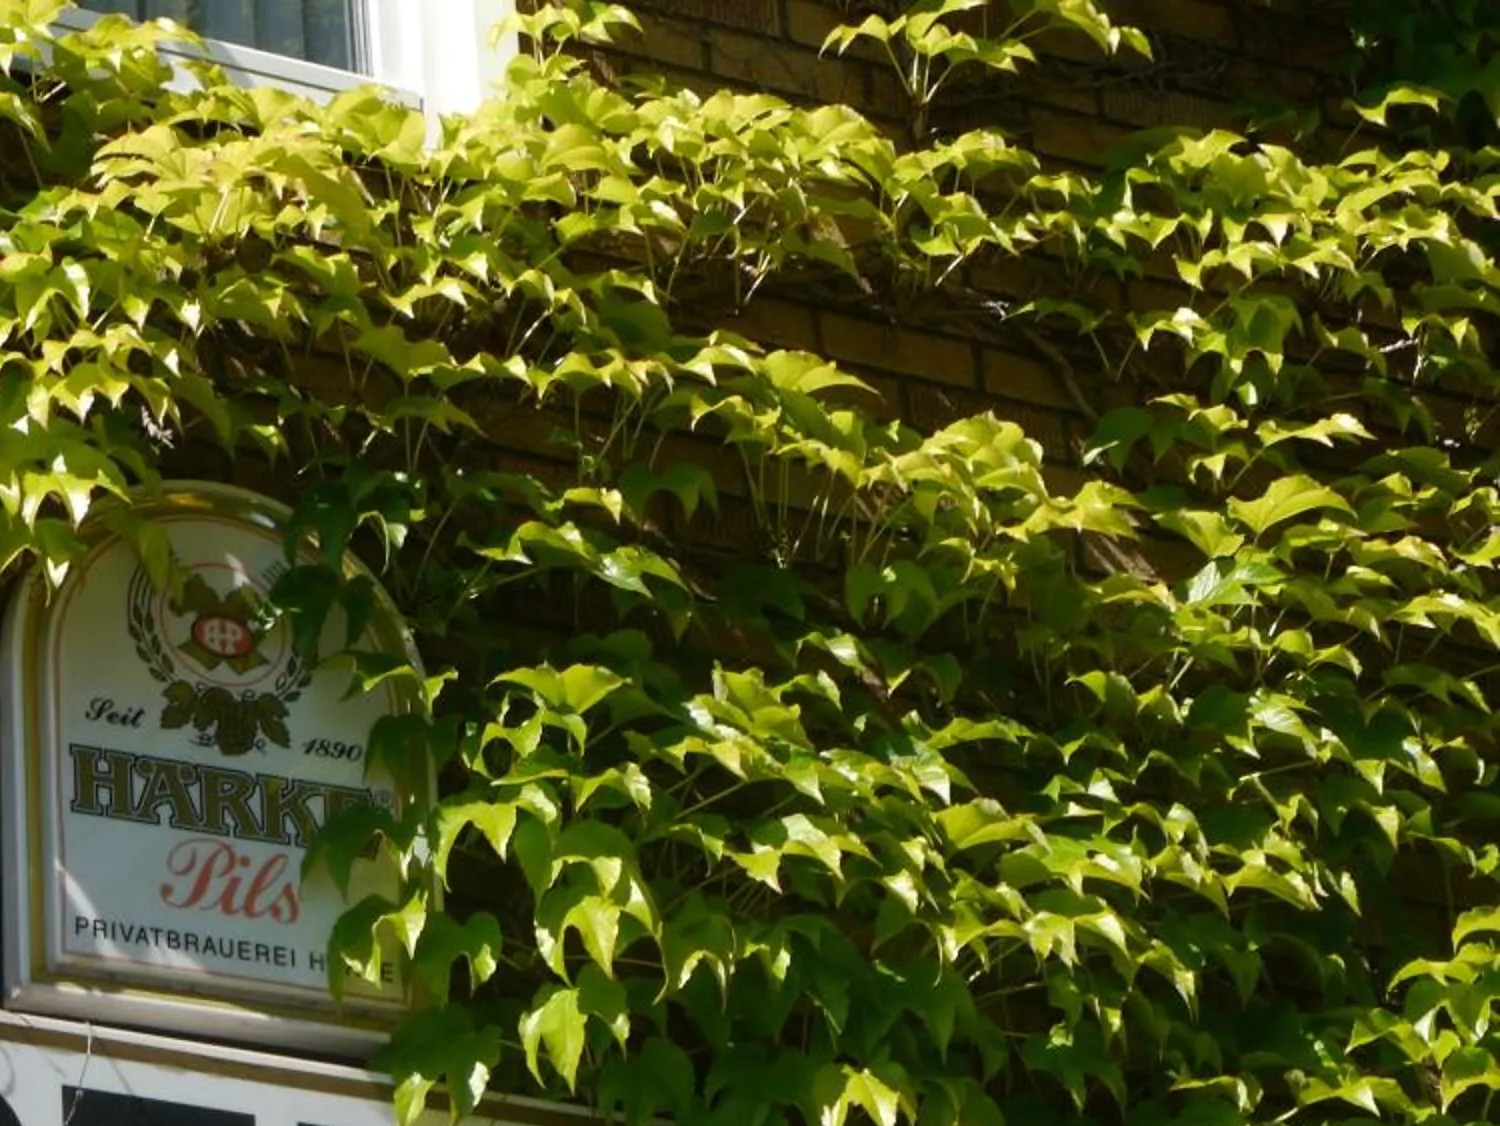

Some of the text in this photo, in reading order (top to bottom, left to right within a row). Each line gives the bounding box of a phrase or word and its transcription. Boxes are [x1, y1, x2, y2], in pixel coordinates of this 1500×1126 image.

[85, 697, 363, 764] Seit 1890
[160, 836, 300, 926] Pils
[74, 916, 296, 969] PRIVATBRAUEREI
